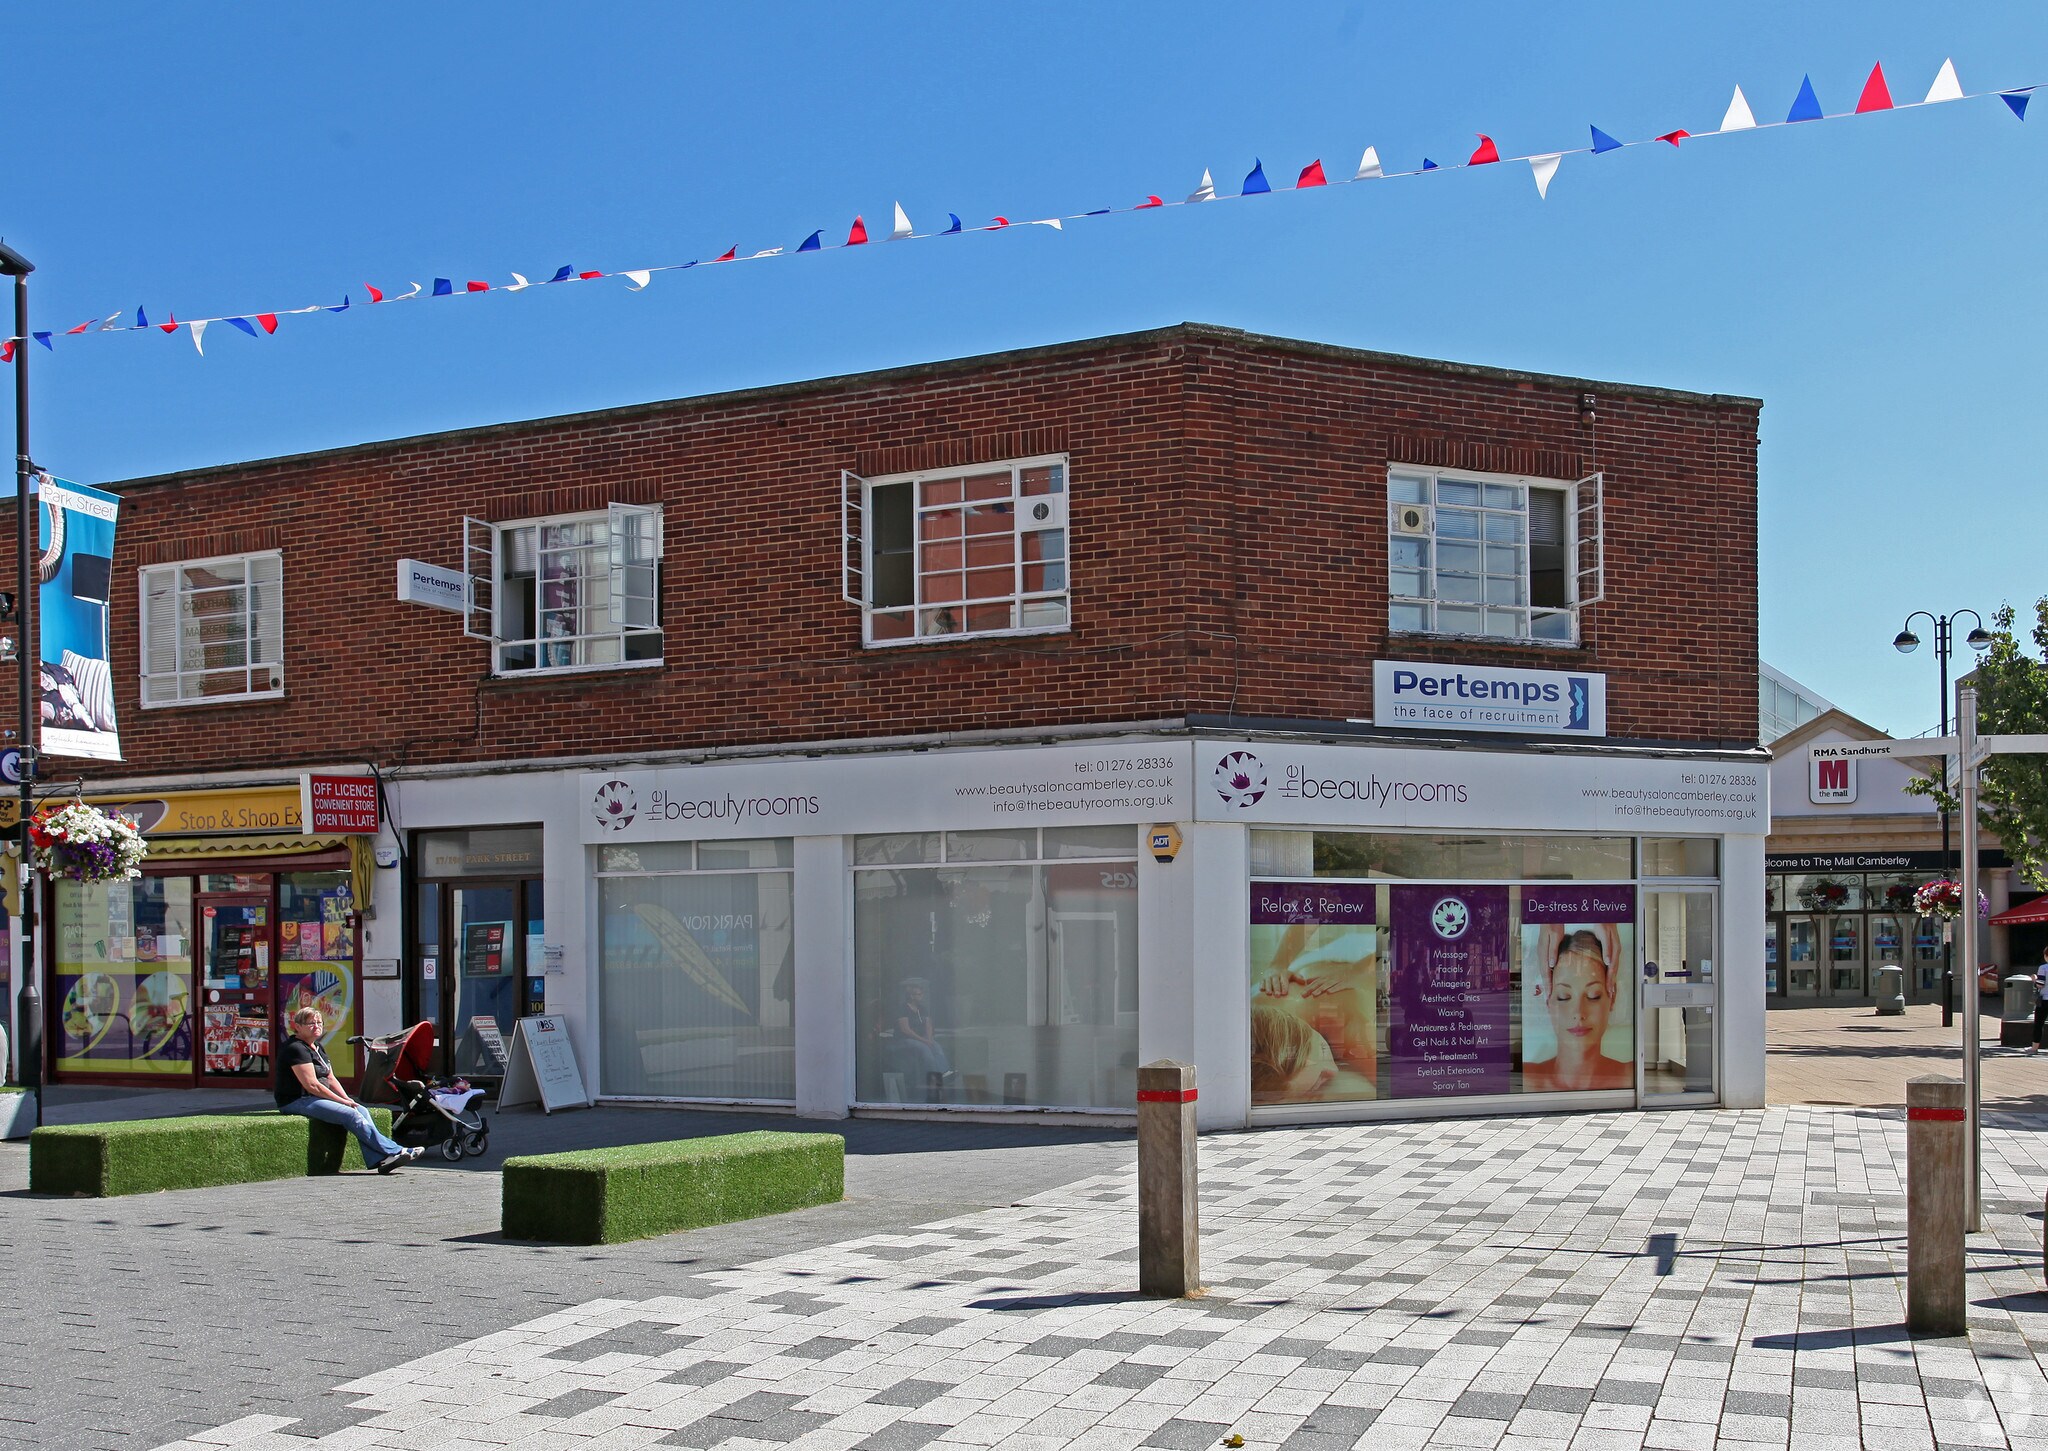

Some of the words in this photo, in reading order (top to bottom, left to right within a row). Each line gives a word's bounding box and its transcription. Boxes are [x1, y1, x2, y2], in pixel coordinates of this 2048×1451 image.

[44, 487, 72, 507] Park
[76, 496, 113, 519] Street
[413, 572, 461, 592] Pertemps
[1393, 670, 1560, 706] Pertemps
[1393, 705, 1416, 717] the
[1423, 706, 1453, 719] face
[1460, 709, 1473, 720] of
[1479, 710, 1560, 724] recruitment
[1813, 748, 1838, 757] RMA
[1840, 746, 1891, 756] Sandhurst
[1074, 761, 1094, 773] tel:
[1096, 759, 1133, 772] 01276
[1136, 757, 1174, 770] 28336
[954, 776, 1174, 796] www.beautysaloncamberley.co.uk
[1278, 764, 1299, 798] the
[1301, 764, 1468, 809] beautyrooms
[1681, 773, 1696, 784] tel:
[1698, 773, 1727, 785] 01276
[1729, 775, 1757, 786] 28336
[313, 782, 332, 796] OFF
[334, 783, 375, 798] LICENCE
[1581, 788, 1757, 803] www.beautysaloncamberley.co.uk
[1832, 789, 1848, 797] mall
[314, 798, 354, 811] CONVENIENT
[354, 800, 375, 812] STORE
[645, 790, 663, 821] the
[664, 789, 820, 825] beautyrooms
[993, 794, 1174, 813] info@thebeautyrooms.org.uk
[179, 811, 216, 831] Stop
[222, 809, 234, 827] &
[238, 807, 280, 828] Shop
[1614, 804, 1757, 820] info@thebeautyrooms.org.uk
[316, 813, 338, 826] OPEN
[338, 814, 356, 827] TILL
[356, 814, 376, 827] LATE
[1153, 837, 1170, 847] ADT
[466, 854, 490, 863] PARK
[494, 852, 531, 863] STREET
[1800, 858, 1811, 867] to
[1813, 857, 1832, 867] The
[1834, 856, 1855, 866] Mall
[1857, 855, 1911, 867] Camberley
[1261, 896, 1299, 913] Relax
[1303, 897, 1314, 913] &
[1319, 897, 1364, 913] Renew
[1528, 899, 1578, 912] De-stress
[1581, 898, 1589, 912] &
[1593, 898, 1627, 912] Revive
[1433, 950, 1468, 960] Massage
[1437, 964, 1463, 973] Facials
[1431, 979, 1471, 989] Antiageing
[1421, 993, 1456, 1002] Aesthetic
[1458, 992, 1481, 1002] Clinics
[1438, 1008, 1465, 1018] Waxing
[1409, 1023, 1448, 1032] Manicures
[1449, 1022, 1456, 1031] &
[1458, 1021, 1492, 1031] Pedicures
[1413, 1037, 1428, 1047] Gel
[1430, 1037, 1449, 1046] Nails
[1451, 1036, 1457, 1046] &
[1459, 1036, 1475, 1046] Nail
[1476, 1035, 1489, 1045] Art
[1424, 1051, 1437, 1062] Eye
[1439, 1051, 1478, 1061] Treatments
[1417, 1066, 1445, 1077] Eyelash
[1447, 1065, 1485, 1076] Extensions
[1432, 1081, 1455, 1092] Spray
[1457, 1080, 1470, 1090] Tan
